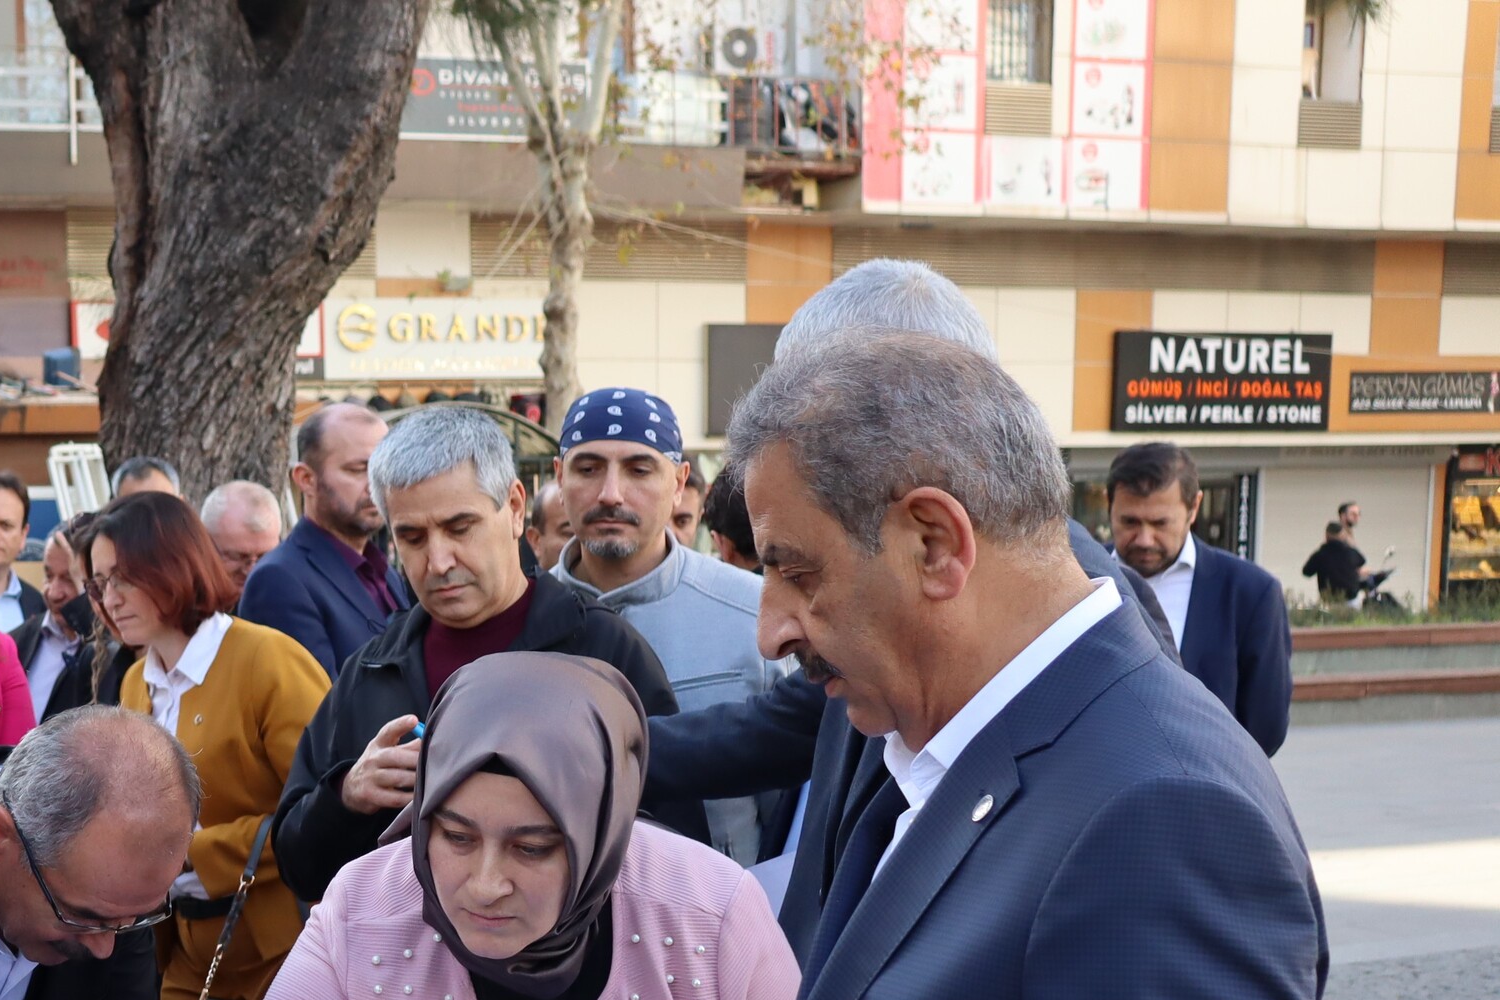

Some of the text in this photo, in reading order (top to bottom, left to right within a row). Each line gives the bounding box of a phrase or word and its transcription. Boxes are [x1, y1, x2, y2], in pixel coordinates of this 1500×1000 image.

[1149, 336, 1311, 375] NATUREL
[1126, 376, 1183, 401] GÜMÜŞ
[1195, 376, 1229, 398] İNCİ
[1240, 377, 1291, 399] DOĞAL
[1294, 380, 1323, 401] TAŞ
[1200, 405, 1255, 424] PERLE
[1266, 405, 1322, 424] STONE
